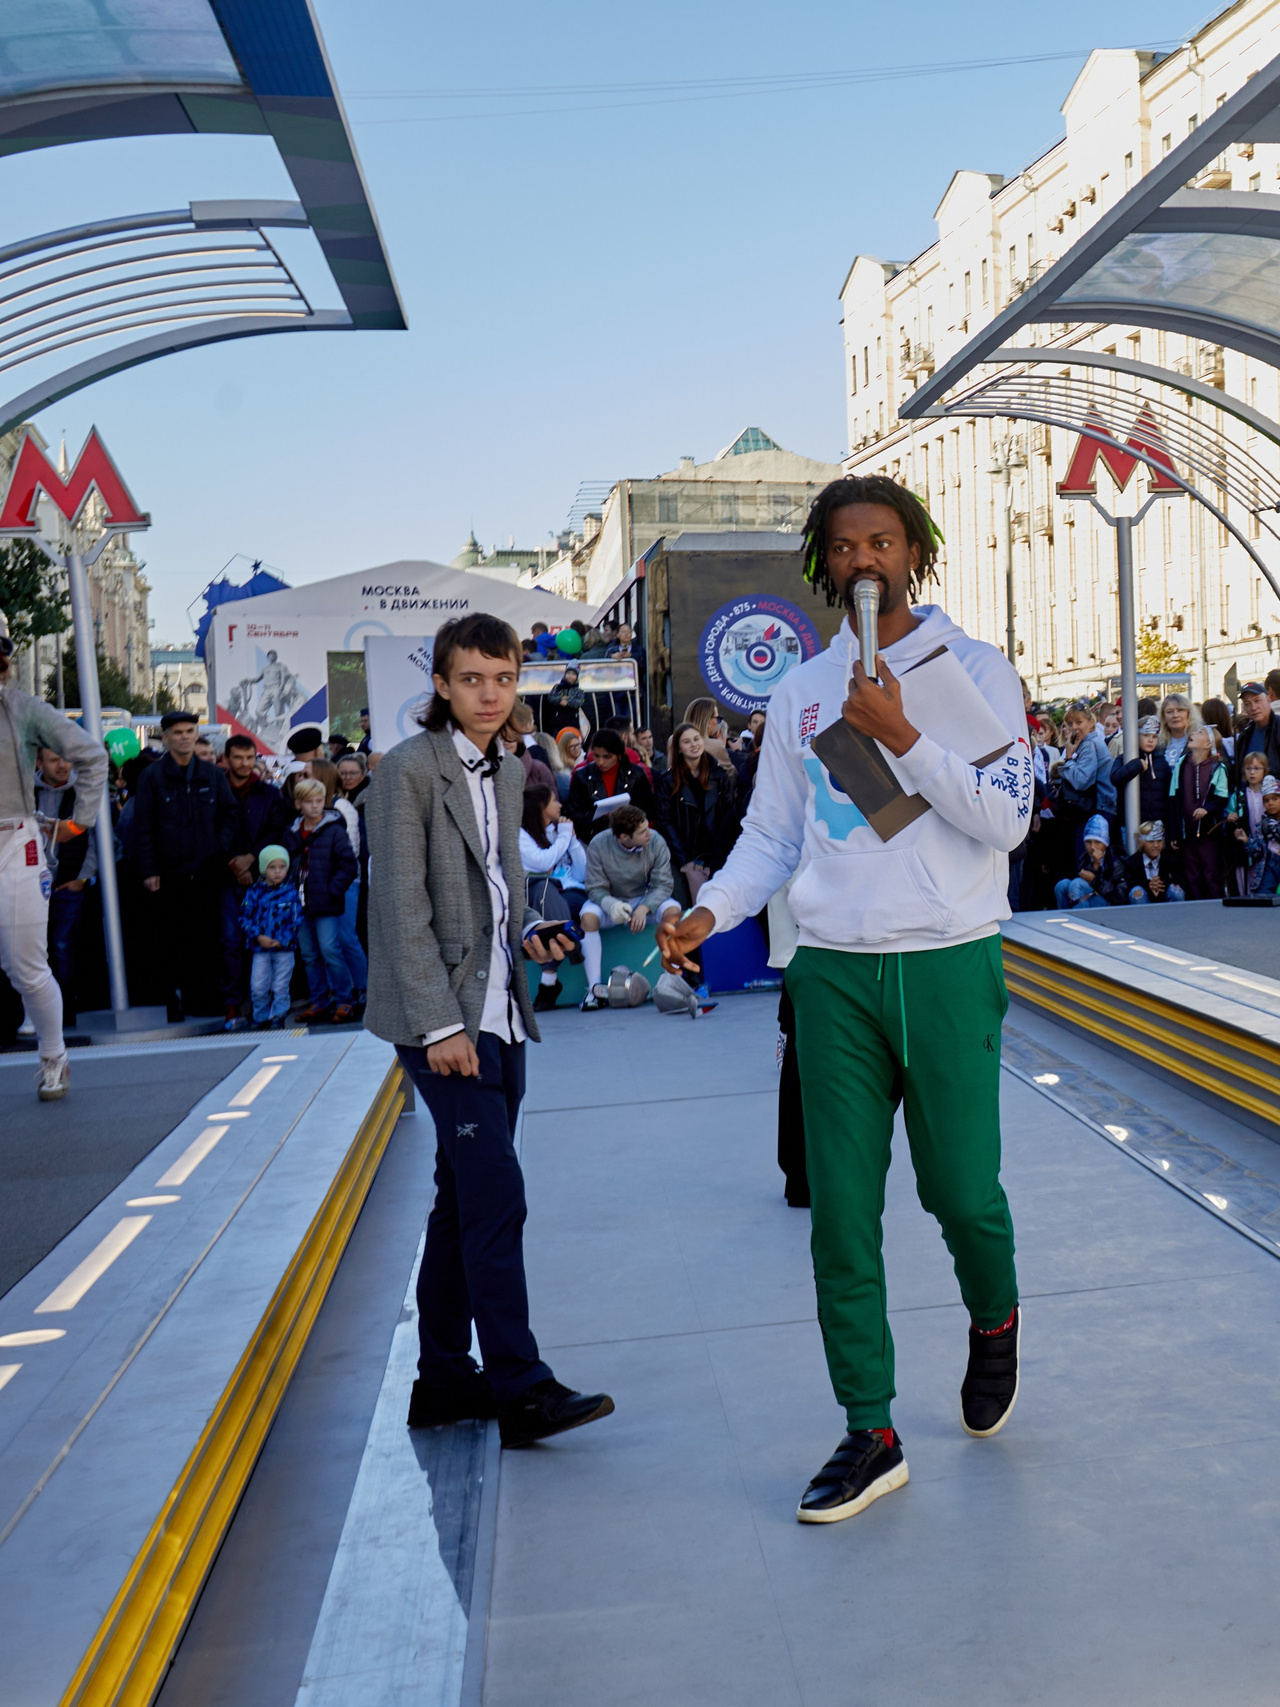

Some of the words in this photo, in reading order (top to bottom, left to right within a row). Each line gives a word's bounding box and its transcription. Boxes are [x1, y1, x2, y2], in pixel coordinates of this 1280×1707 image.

[361, 585, 421, 597] МОСКВА
[379, 599, 388, 610] В
[390, 599, 470, 611] ДВИЖЕНИИ
[733, 601, 752, 616] 875
[758, 600, 801, 625] МОСКВА
[704, 614, 731, 654] ГОРОДА
[704, 655, 722, 683] ДЕНЬ
